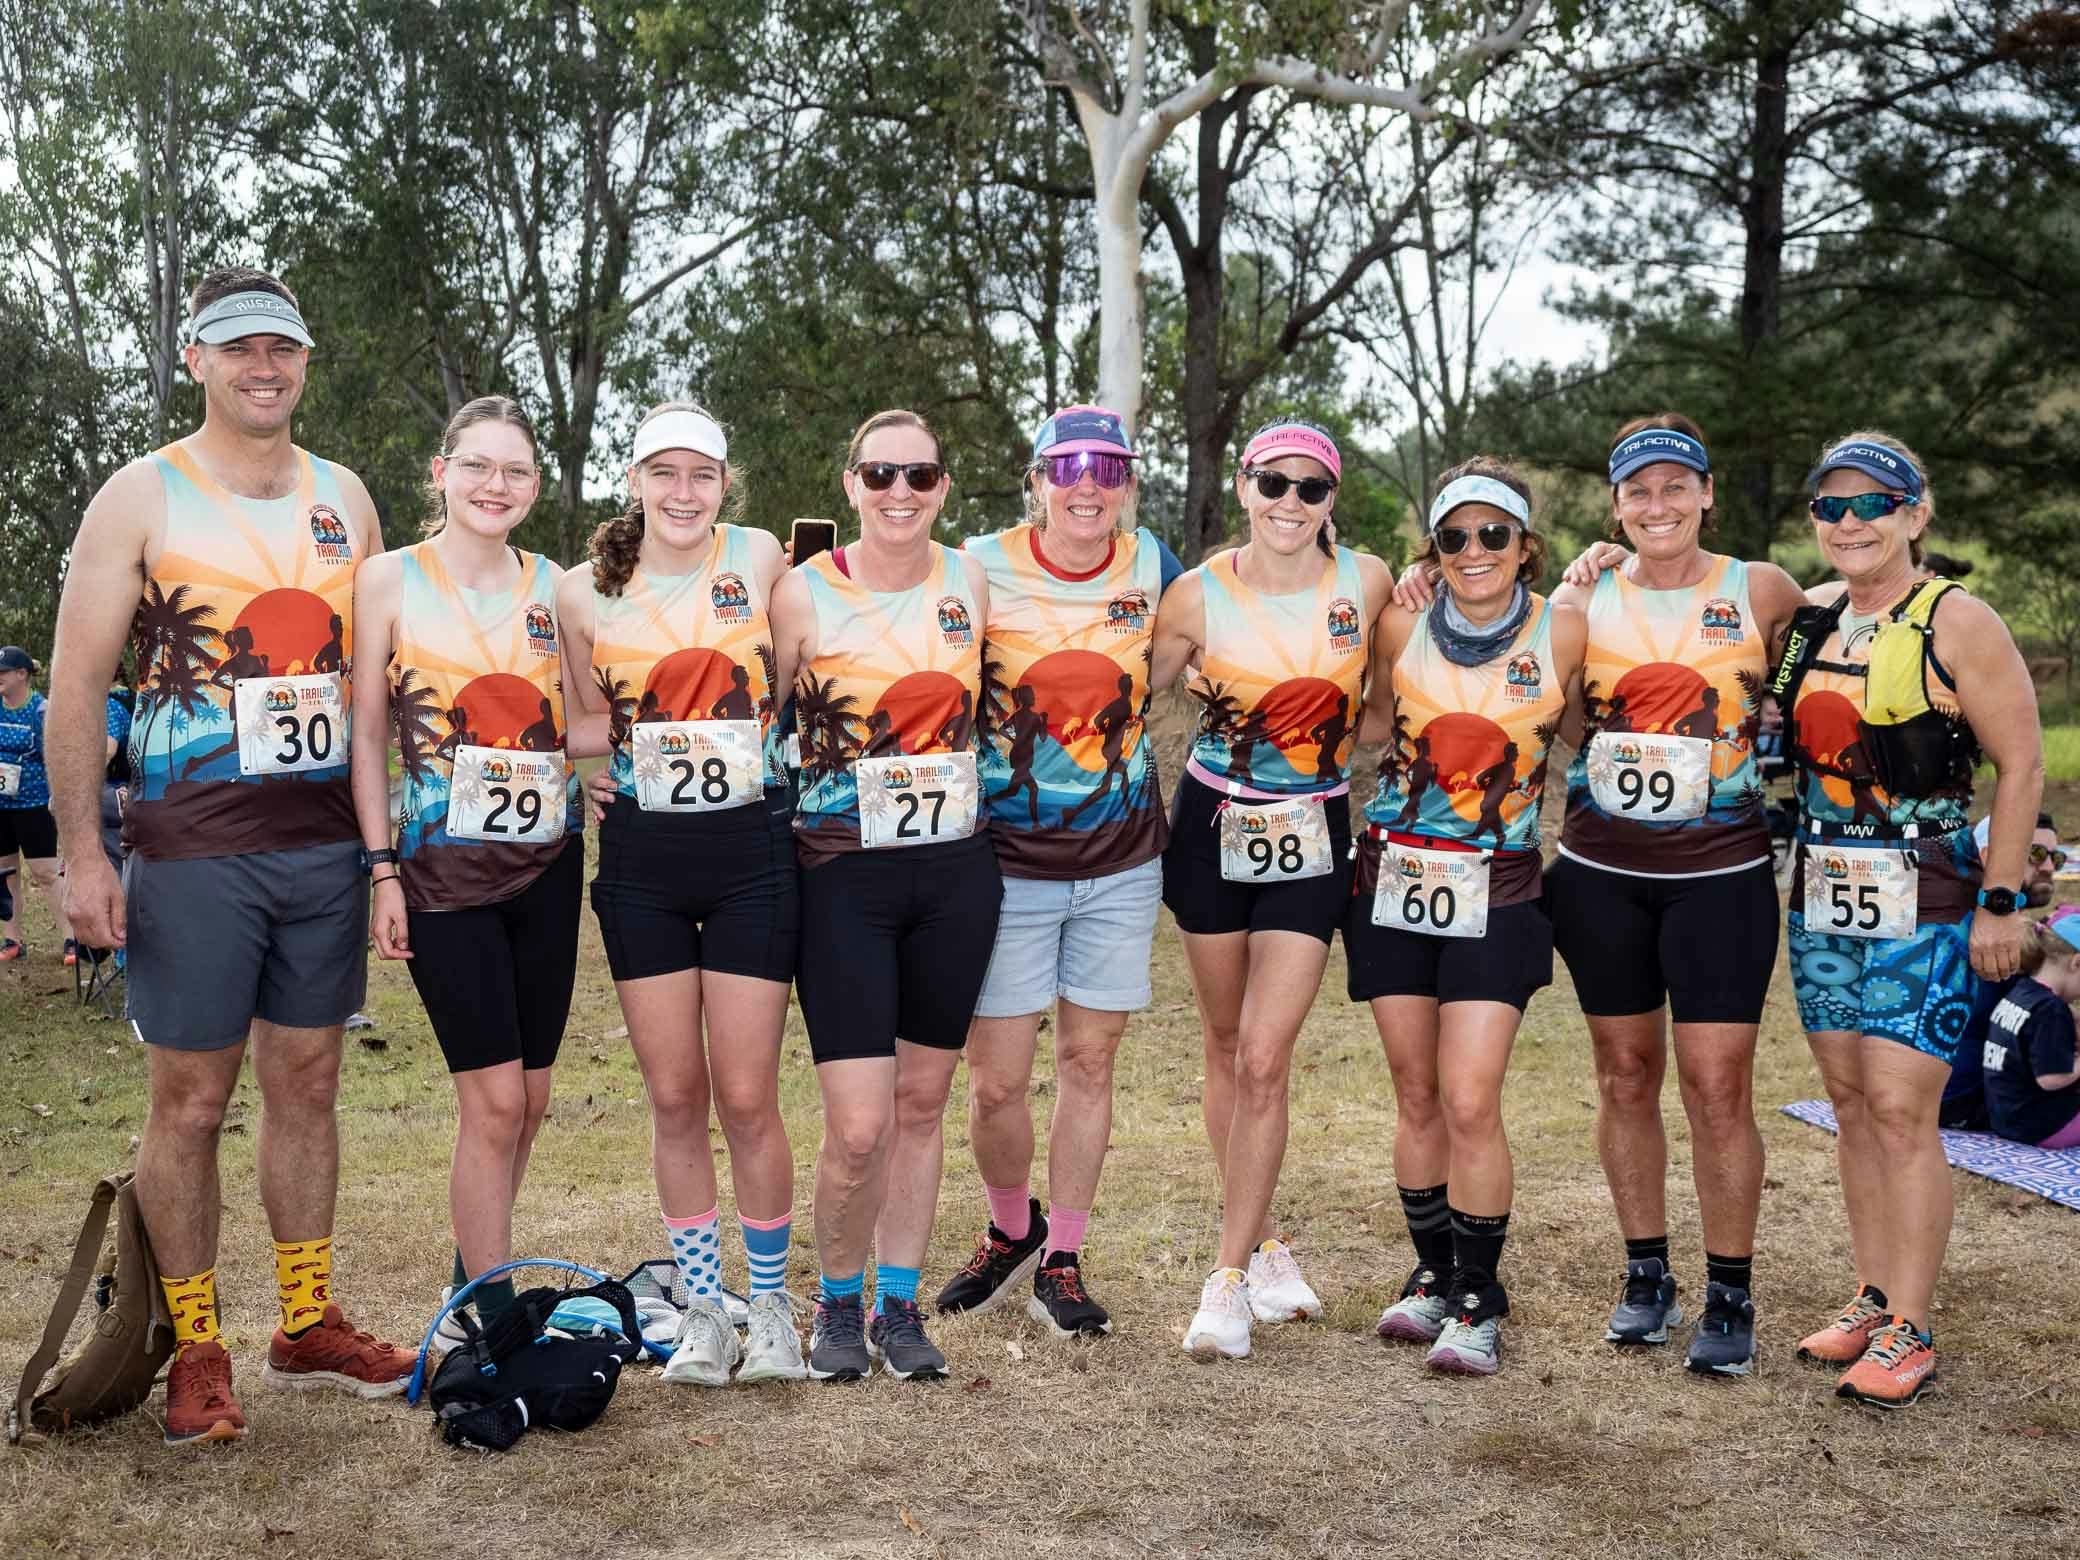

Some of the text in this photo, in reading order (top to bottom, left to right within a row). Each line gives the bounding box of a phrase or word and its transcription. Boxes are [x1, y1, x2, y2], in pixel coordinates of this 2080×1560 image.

[275, 713, 331, 764] 30
[669, 758, 730, 805] 28
[1617, 768, 1675, 813] 99
[483, 787, 541, 834] 29
[895, 791, 946, 838] 27
[1247, 834, 1304, 876] 98
[1402, 883, 1456, 929] 60
[1831, 883, 1881, 930] 55
